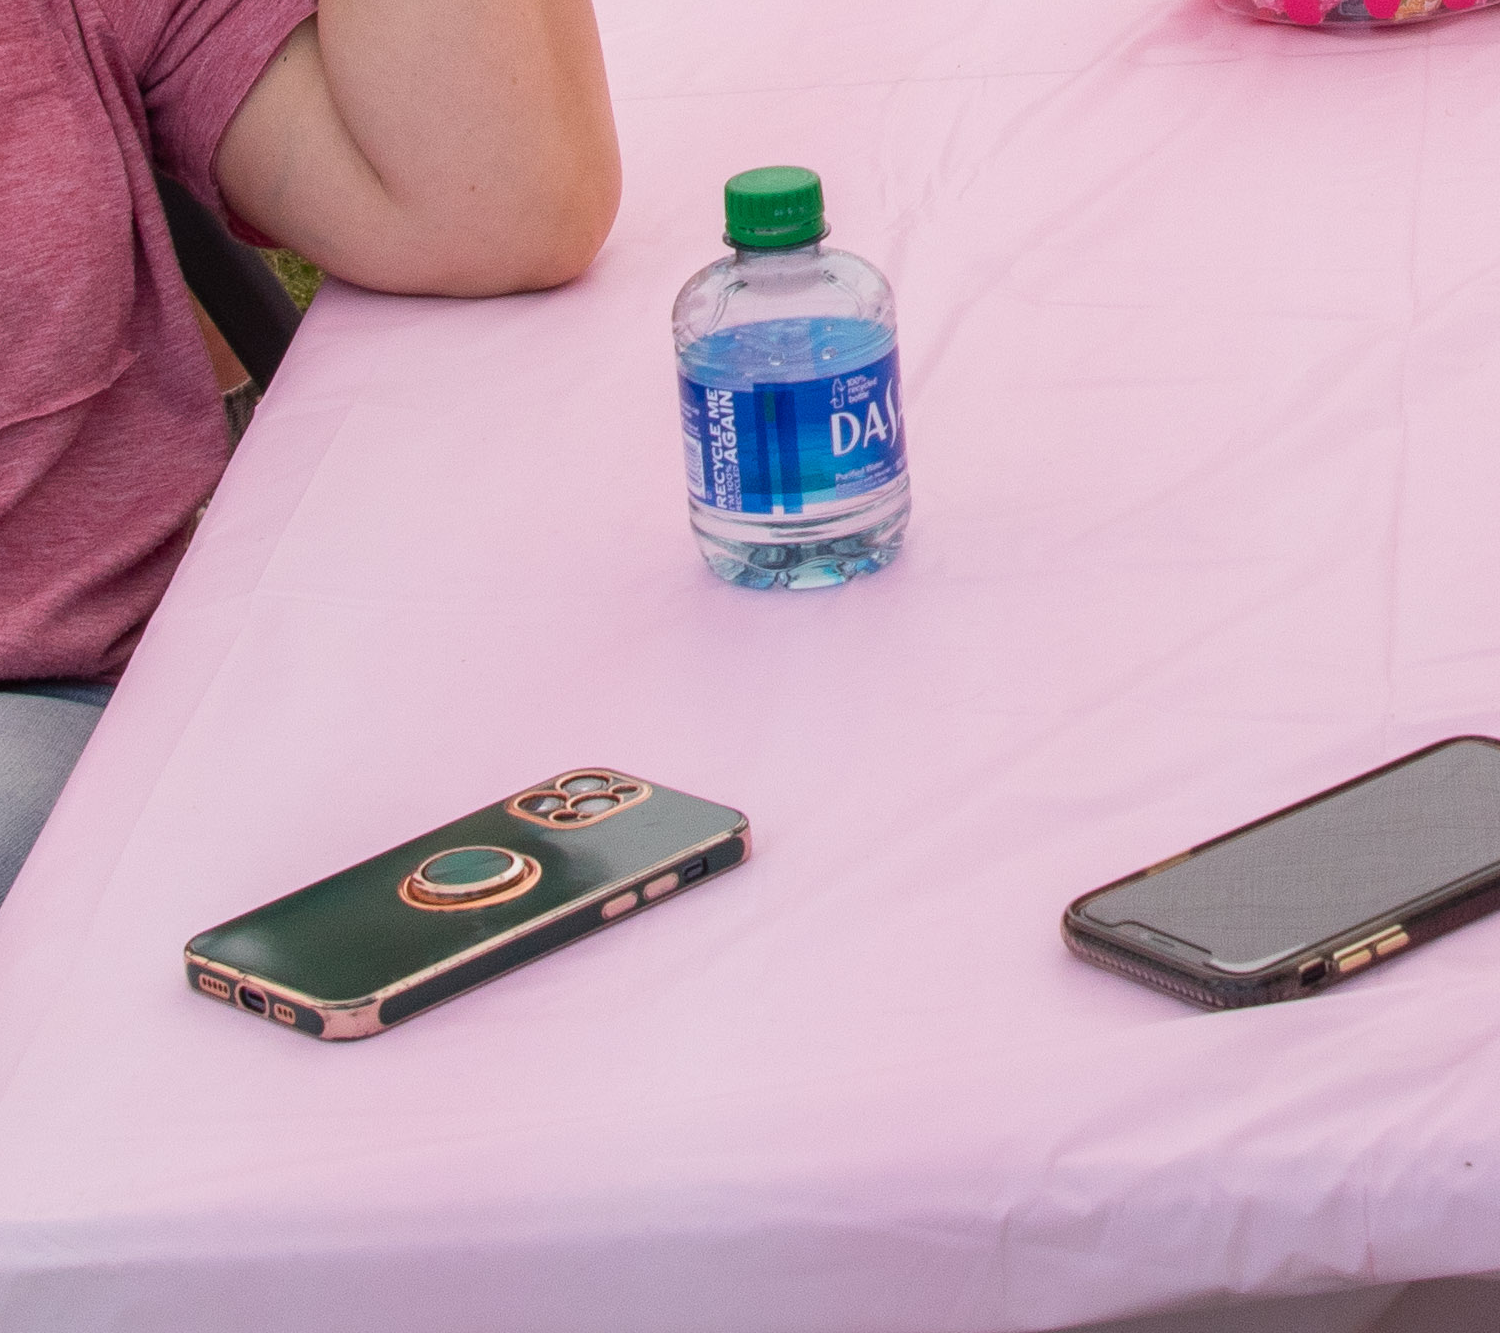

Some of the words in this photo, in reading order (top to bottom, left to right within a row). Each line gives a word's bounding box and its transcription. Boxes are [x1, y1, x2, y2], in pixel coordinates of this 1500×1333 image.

[707, 388, 720, 418] ME
[718, 390, 738, 464] AGAIN
[710, 423, 728, 509] RECYCLE
[725, 464, 734, 492] 100%
